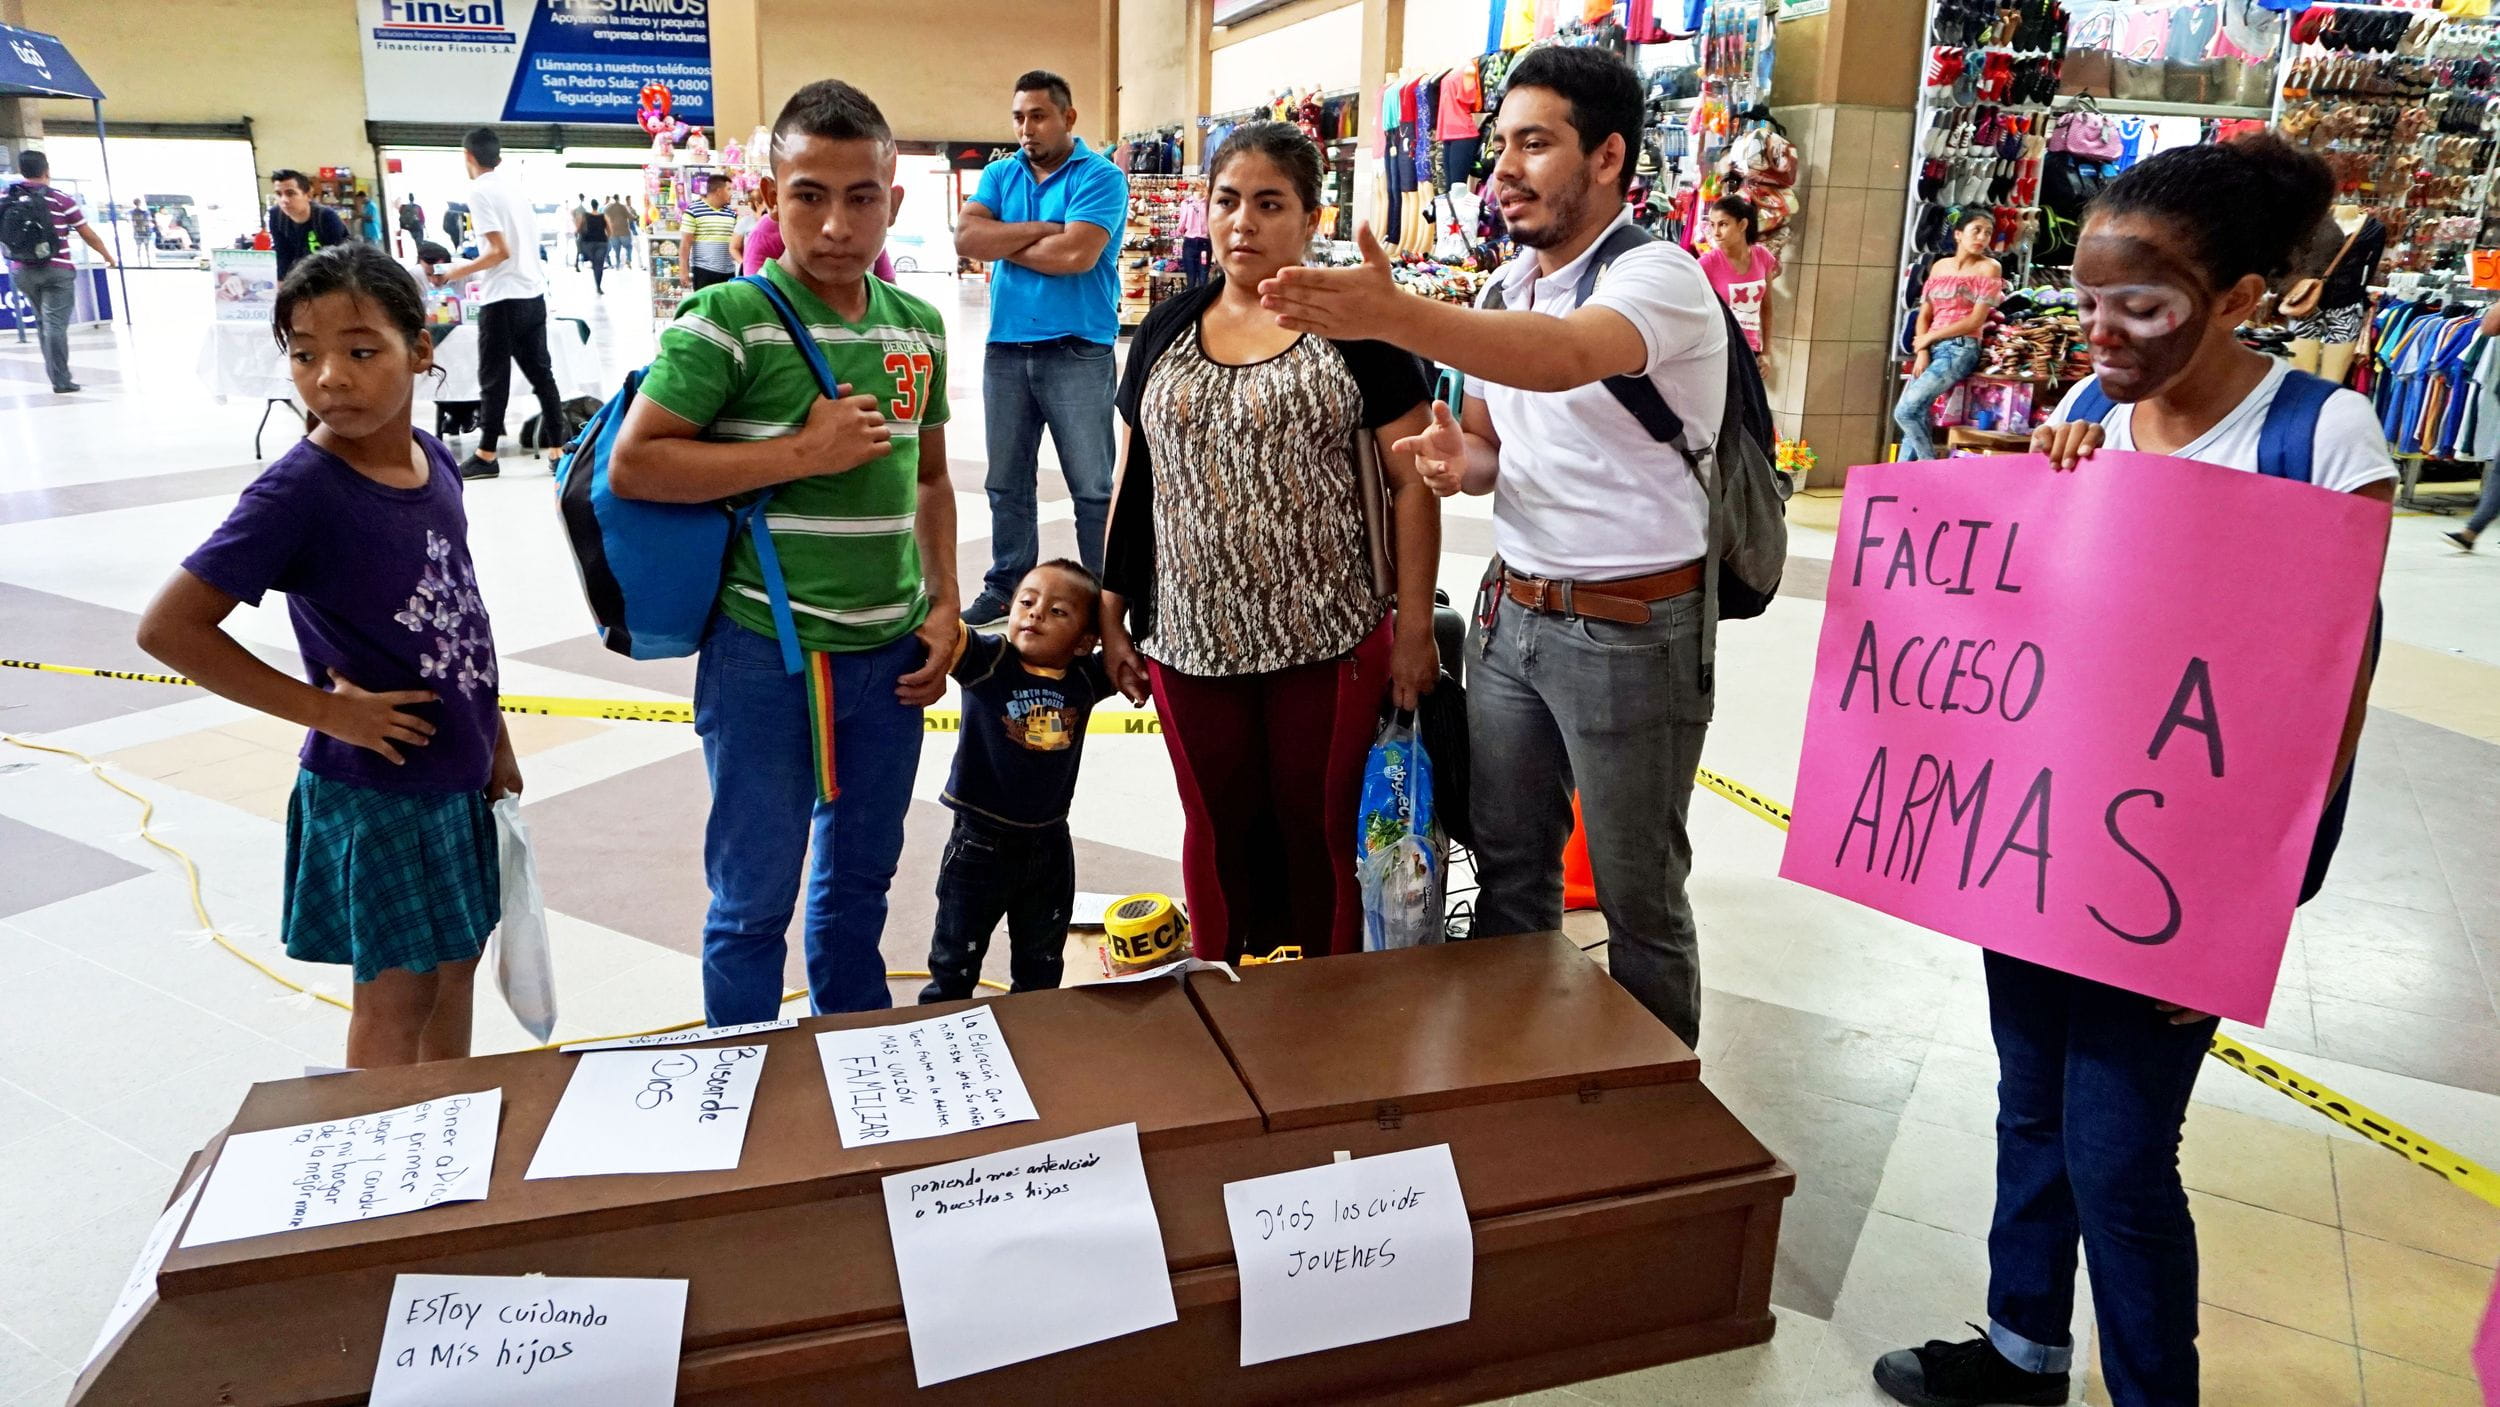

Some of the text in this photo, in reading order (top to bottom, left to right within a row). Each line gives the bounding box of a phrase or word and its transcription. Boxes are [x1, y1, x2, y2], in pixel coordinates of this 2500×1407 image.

[551, 12, 706, 29] Apoyamos la micro y pequeña
[593, 30, 707, 43] empresa de Honduras
[377, 42, 516, 54] Financiera Finsol S.A.
[536, 58, 713, 75] Llámanos a nuestros teléfonos:
[542, 74, 567, 87] San
[569, 75, 606, 88] Pedro
[608, 76, 639, 89] Sula:
[552, 90, 633, 107] Tegucigalpa:
[2477, 256, 2500, 280] 5
[883, 351, 933, 423] 37
[1839, 619, 2225, 778] ACCESO A
[1107, 903, 1189, 959] RECA
[839, 1055, 891, 1141] FAMILIAR
[887, 1062, 919, 1105] UNIÓN
[315, 1124, 343, 1141] de
[364, 1110, 409, 1145] lugar
[443, 1096, 472, 1147] Poner
[392, 1102, 433, 1193] en primer
[436, 1155, 453, 1169] a
[293, 1161, 323, 1197] mejor
[317, 1160, 357, 1205] hogar
[911, 1168, 981, 1202] poniendo
[935, 1188, 1014, 1215] nuestros
[1025, 1181, 1070, 1200] hijos
[498, 1299, 608, 1327] cuidando
[495, 1337, 574, 1375] hijos
